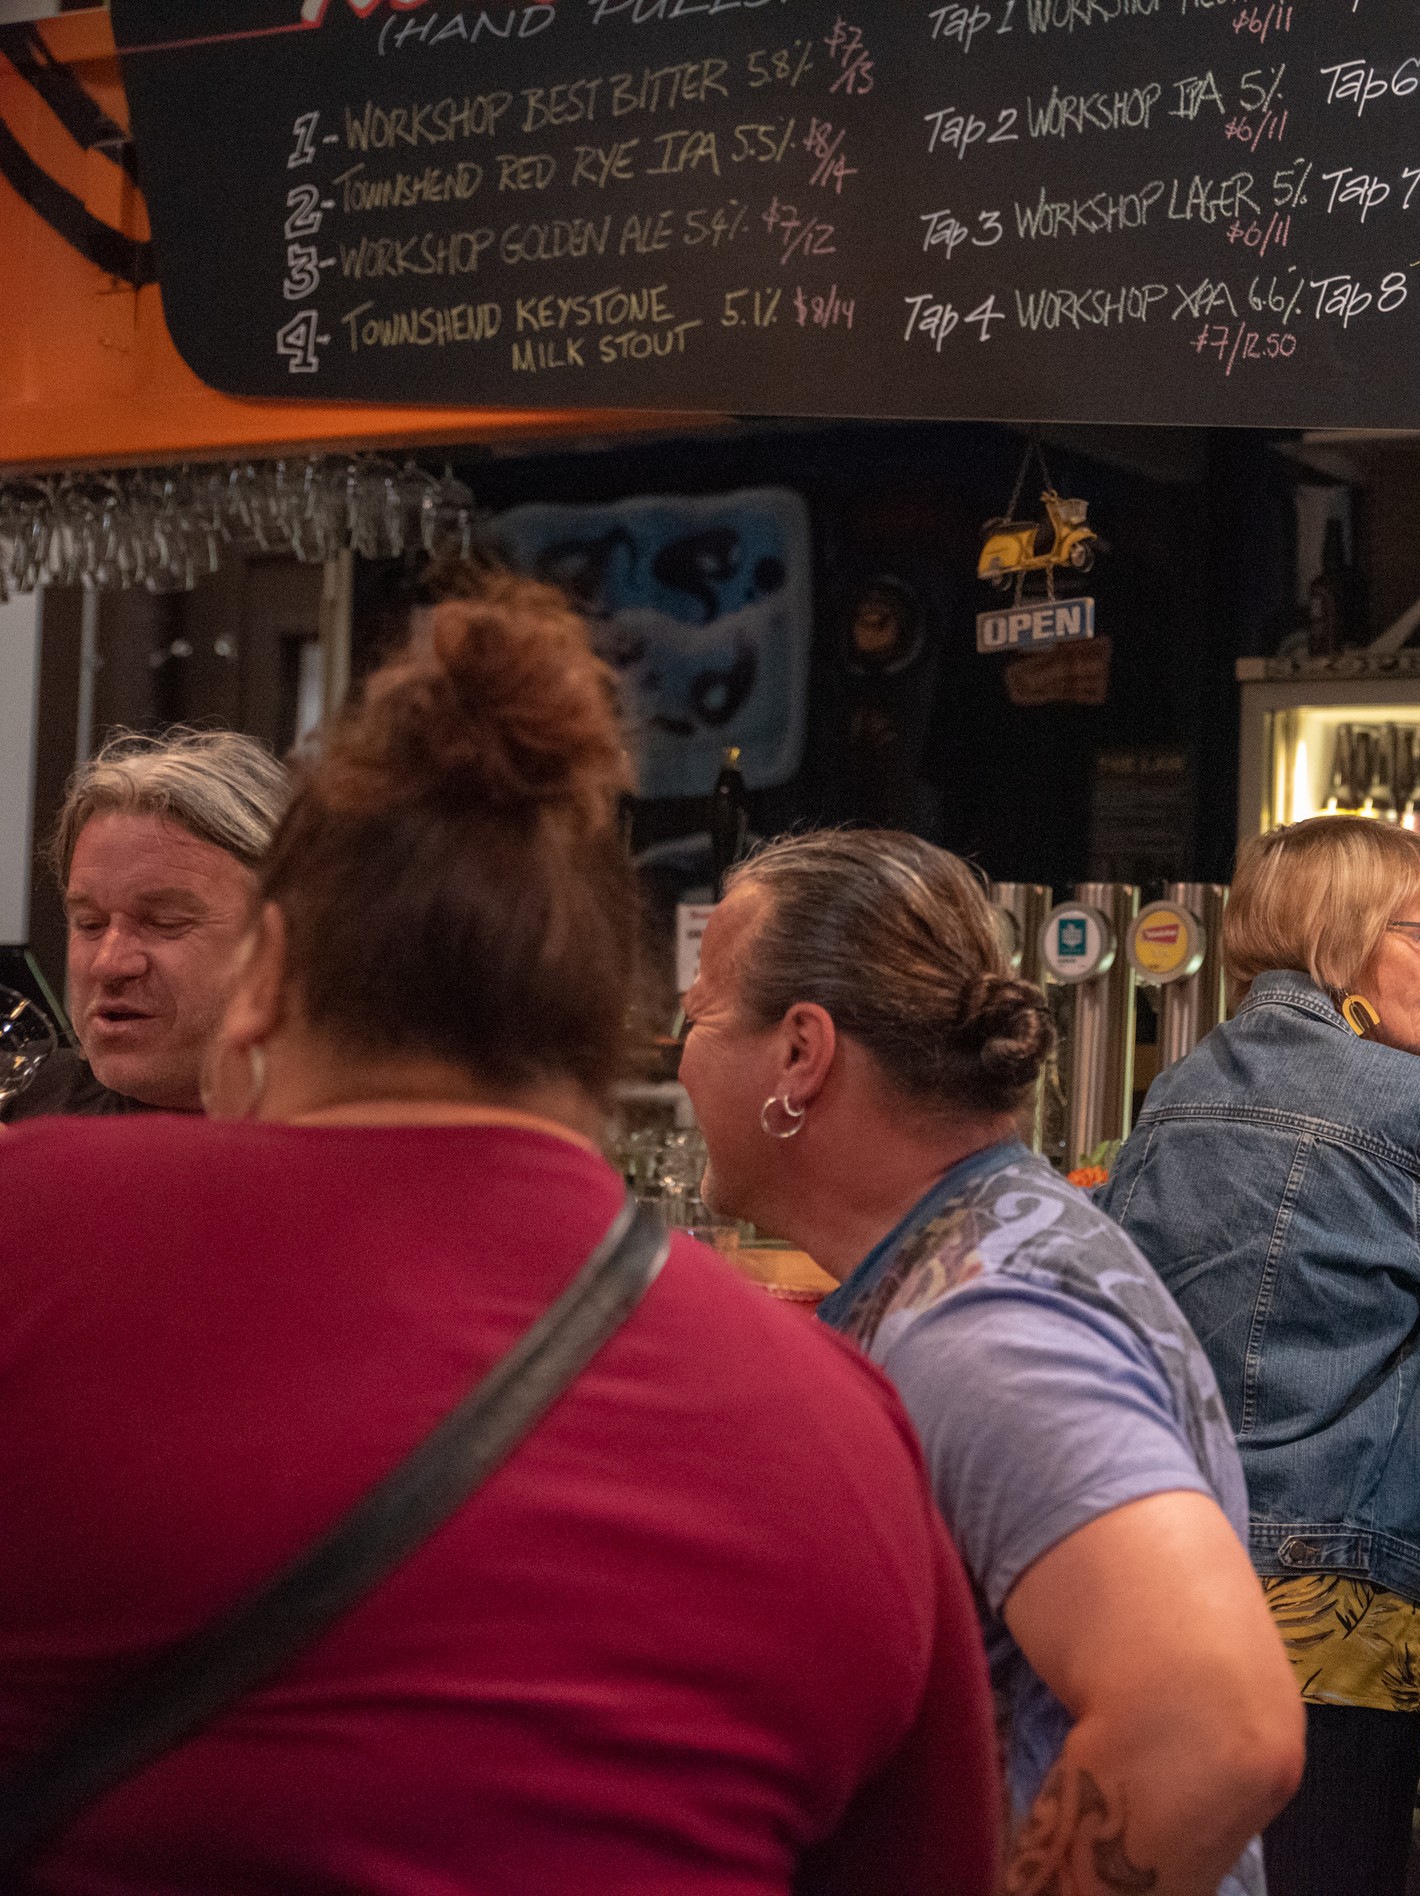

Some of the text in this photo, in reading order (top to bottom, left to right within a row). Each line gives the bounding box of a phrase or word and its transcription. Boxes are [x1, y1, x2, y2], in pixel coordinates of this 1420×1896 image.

[928, 2, 990, 54] Tap
[1026, 0, 1160, 35] WORKS
[1231, 4, 1293, 44] $6/11
[345, 91, 512, 153] WORKSHOP
[522, 79, 600, 133] BEST
[609, 59, 730, 117] BITTER
[923, 63, 1288, 160] Tap 2 WORKSHOP IPA 5%
[1320, 58, 1389, 117] Tap
[1223, 110, 1289, 153] $6/11
[333, 162, 484, 215] TOWNSHEND
[496, 154, 556, 192] RED
[571, 138, 641, 189] RYE
[646, 130, 721, 176] IPA
[731, 117, 797, 164] 5.5%
[1322, 166, 1390, 224] Tap
[919, 157, 1314, 260] Tap 3 WORKSHOP LAGER 5%
[1225, 210, 1291, 258] $6/11
[339, 229, 494, 280] WORKSHOP
[501, 216, 611, 265] GOLDEN
[619, 210, 676, 256] ALE
[341, 300, 502, 353] TOWNSHEND
[516, 284, 675, 333] KEYSTONE
[902, 293, 959, 353] Tap
[961, 291, 1007, 342] 4
[1015, 282, 1170, 331] WORKSHOP
[1309, 271, 1408, 330] Tap 8
[512, 319, 703, 373] MILK STOUT
[982, 605, 1081, 646] OPEN
